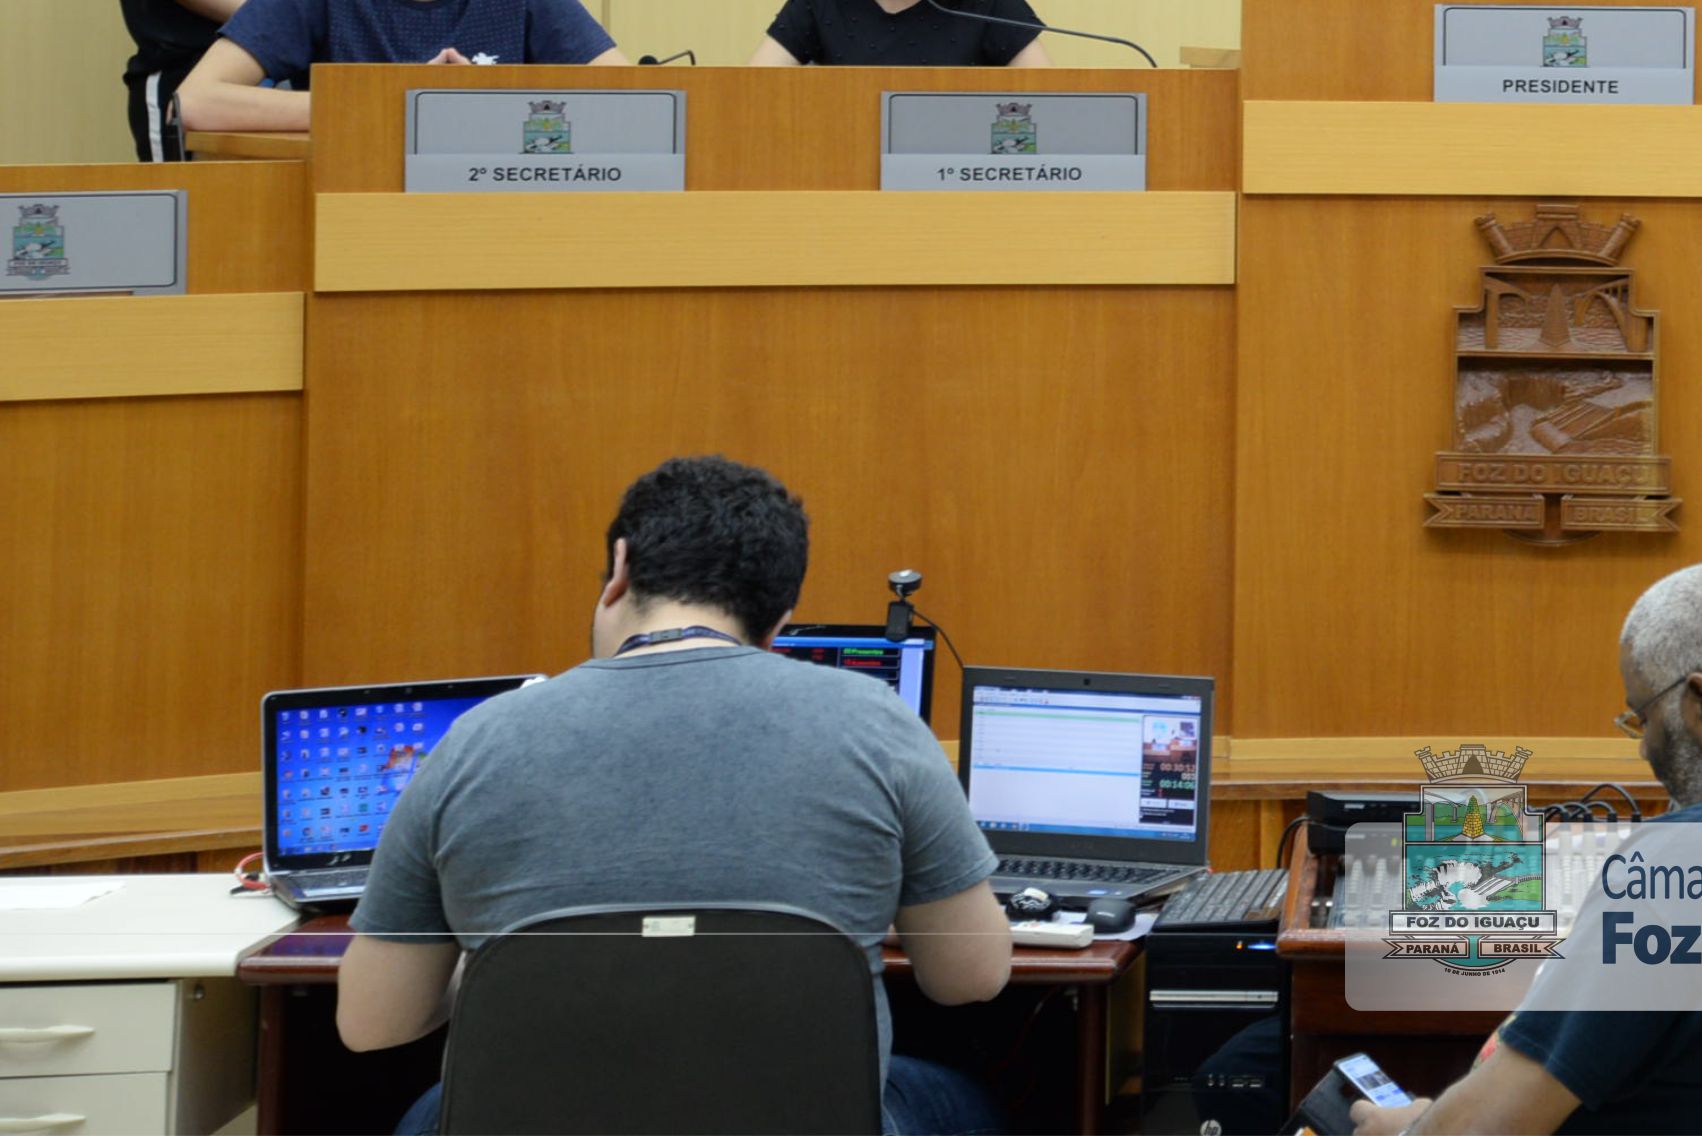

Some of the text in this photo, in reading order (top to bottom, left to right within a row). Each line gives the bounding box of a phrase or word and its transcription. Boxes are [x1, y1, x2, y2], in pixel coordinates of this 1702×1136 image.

[1502, 79, 1619, 94] PRESIDENTE
[468, 164, 622, 182] 2º SECRETÁRIO
[937, 164, 1082, 182] 1º SECRETÁRIO
[1458, 463, 1506, 482] FOZ
[1512, 464, 1548, 482] DO
